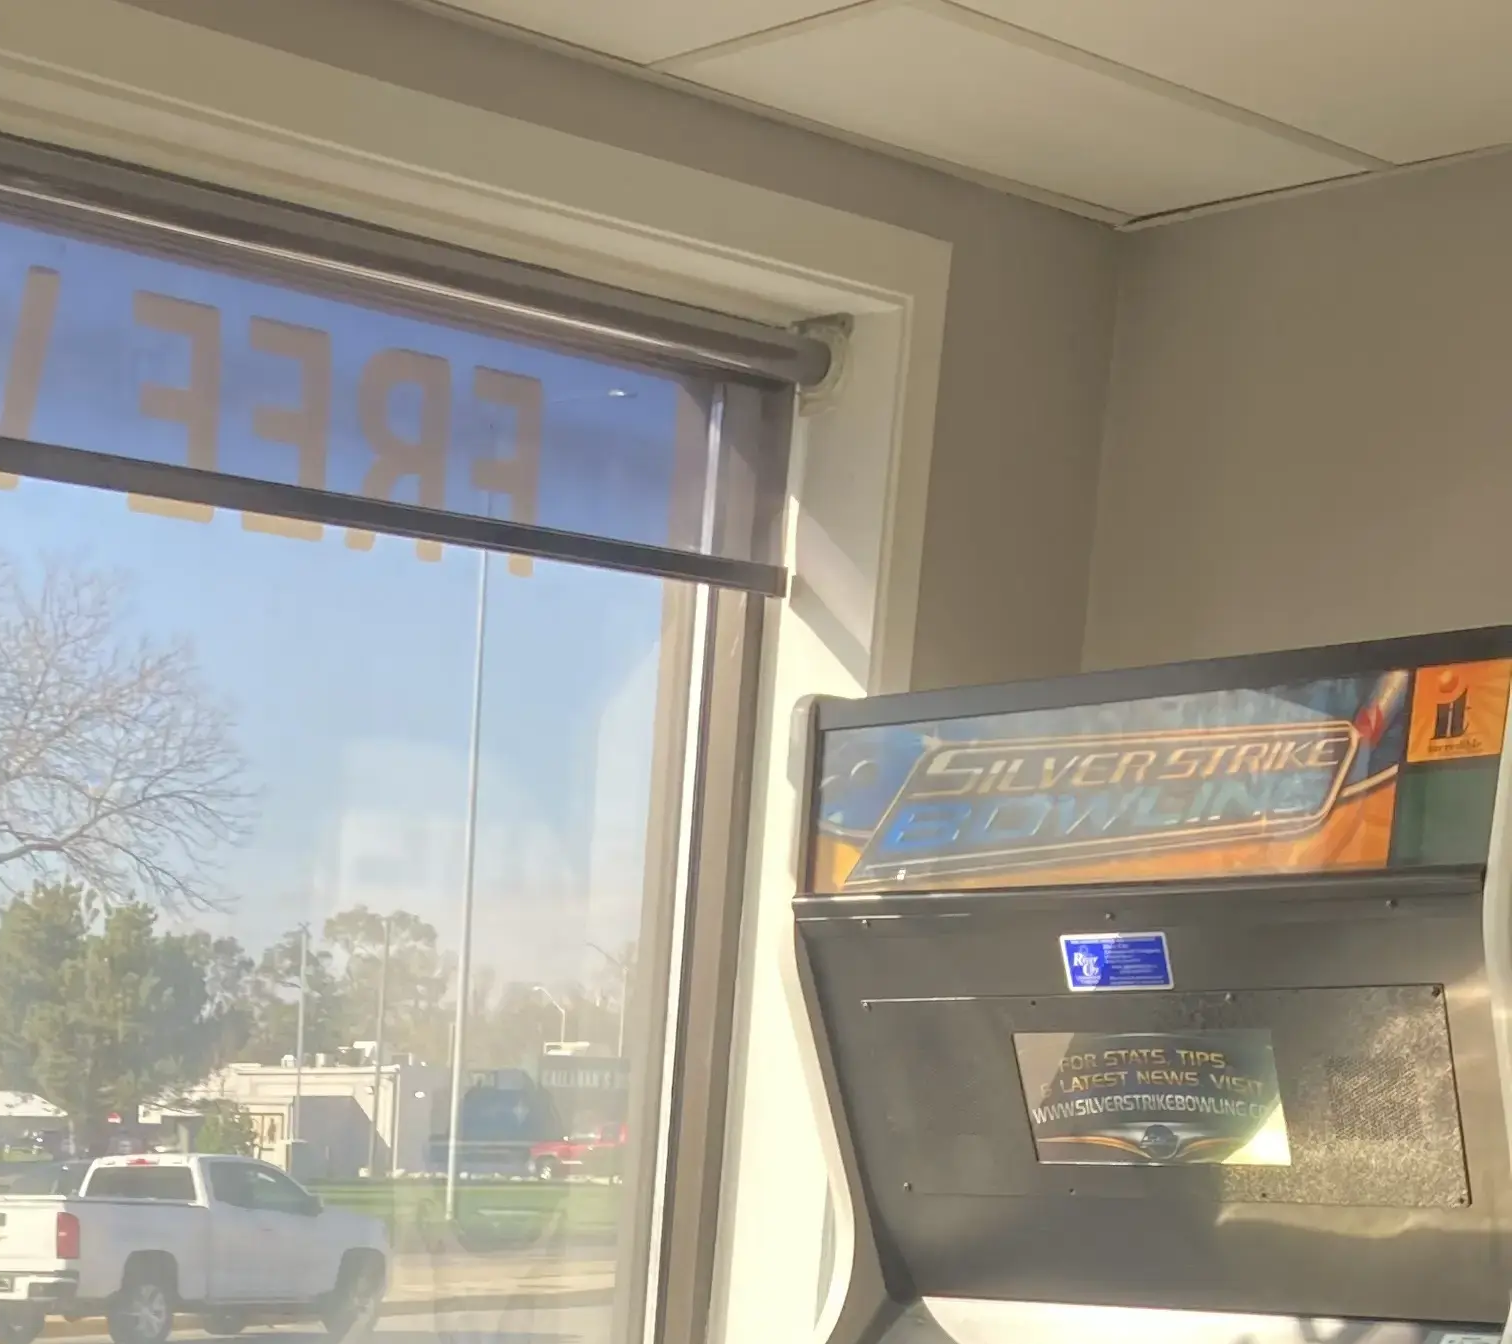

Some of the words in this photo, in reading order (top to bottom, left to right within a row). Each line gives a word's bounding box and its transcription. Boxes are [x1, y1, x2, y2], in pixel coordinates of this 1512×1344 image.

[906, 748, 1158, 799] SILVER
[1156, 737, 1350, 781] STRIKE
[885, 770, 1331, 847] BOWLING
[1059, 1053, 1097, 1073] FOR
[1059, 1070, 1129, 1094] LATEST
[1209, 1073, 1265, 1097] VISIT
